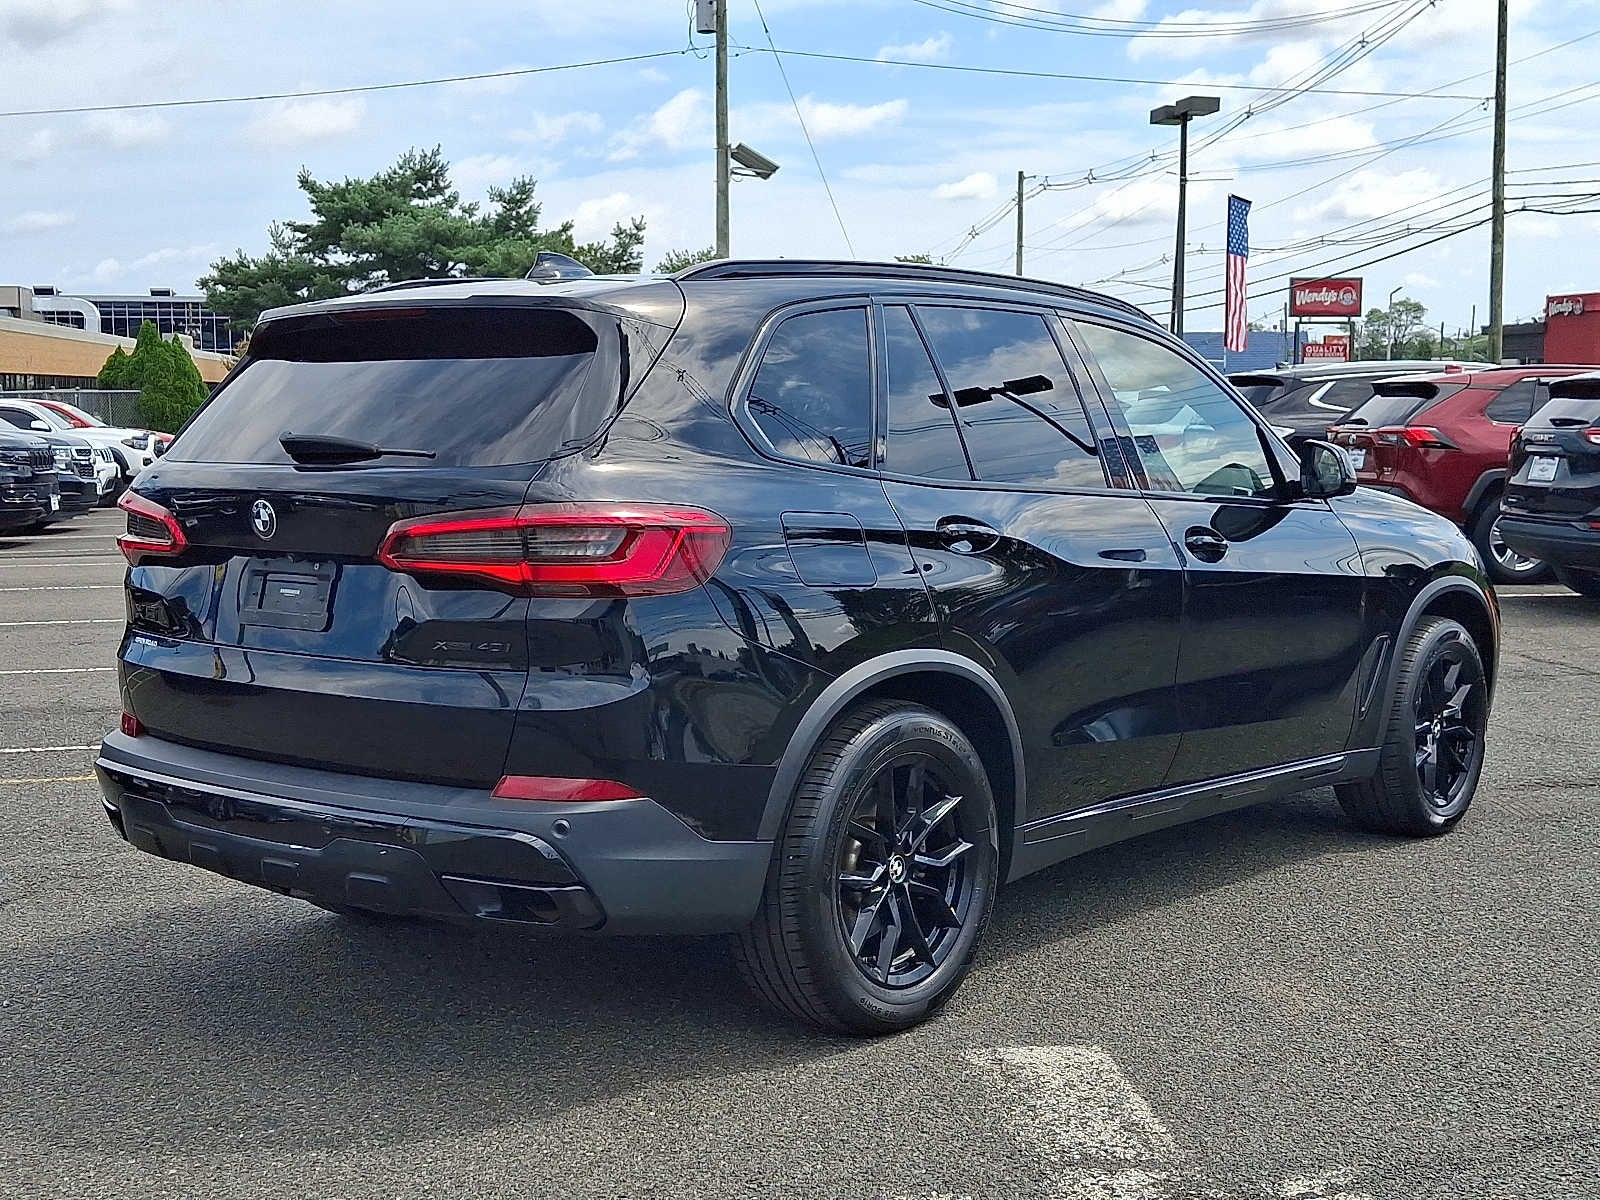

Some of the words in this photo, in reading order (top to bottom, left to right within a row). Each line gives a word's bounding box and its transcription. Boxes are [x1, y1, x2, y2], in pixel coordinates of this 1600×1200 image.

[1295, 286, 1338, 306] Wendy's
[1549, 297, 1573, 317] Wendy's
[1305, 345, 1345, 353] QUALITY
